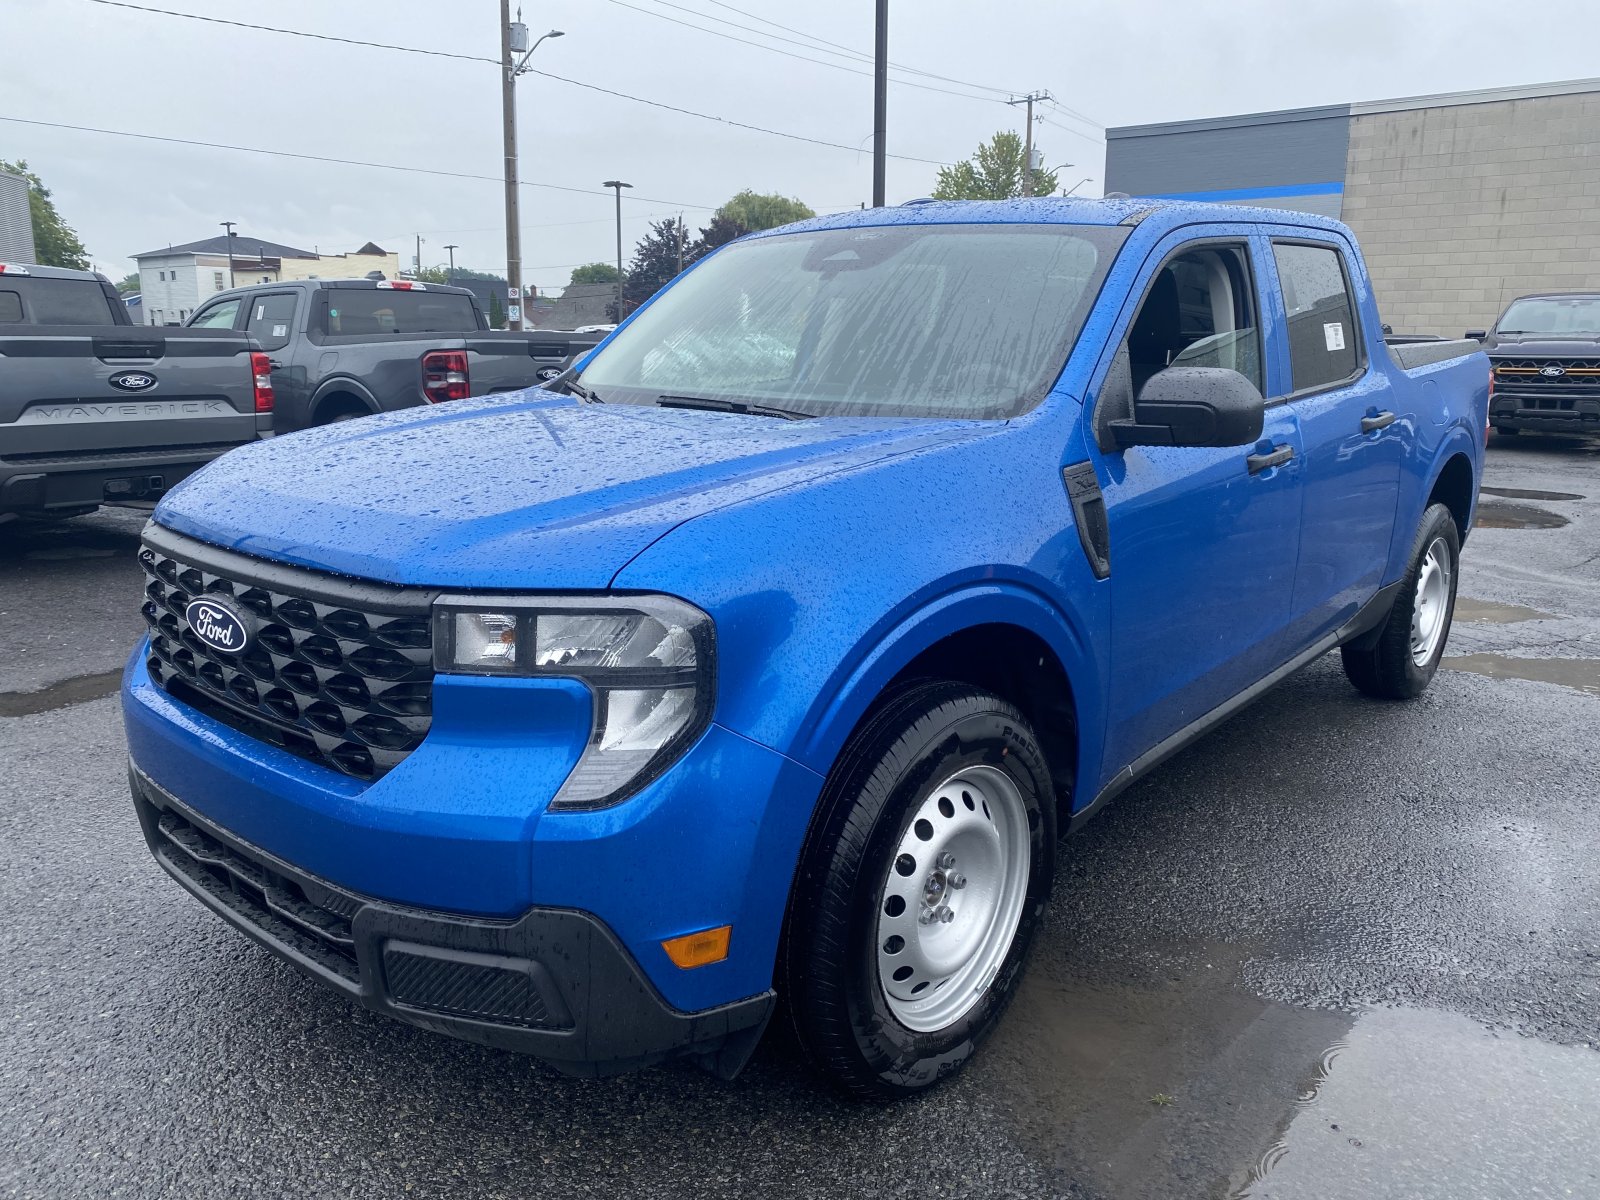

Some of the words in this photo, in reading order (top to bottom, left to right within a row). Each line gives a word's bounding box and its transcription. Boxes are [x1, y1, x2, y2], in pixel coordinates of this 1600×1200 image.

[35, 401, 224, 420] MAVERICK
[1075, 478, 1096, 490] XL
[196, 606, 234, 646] Ford
